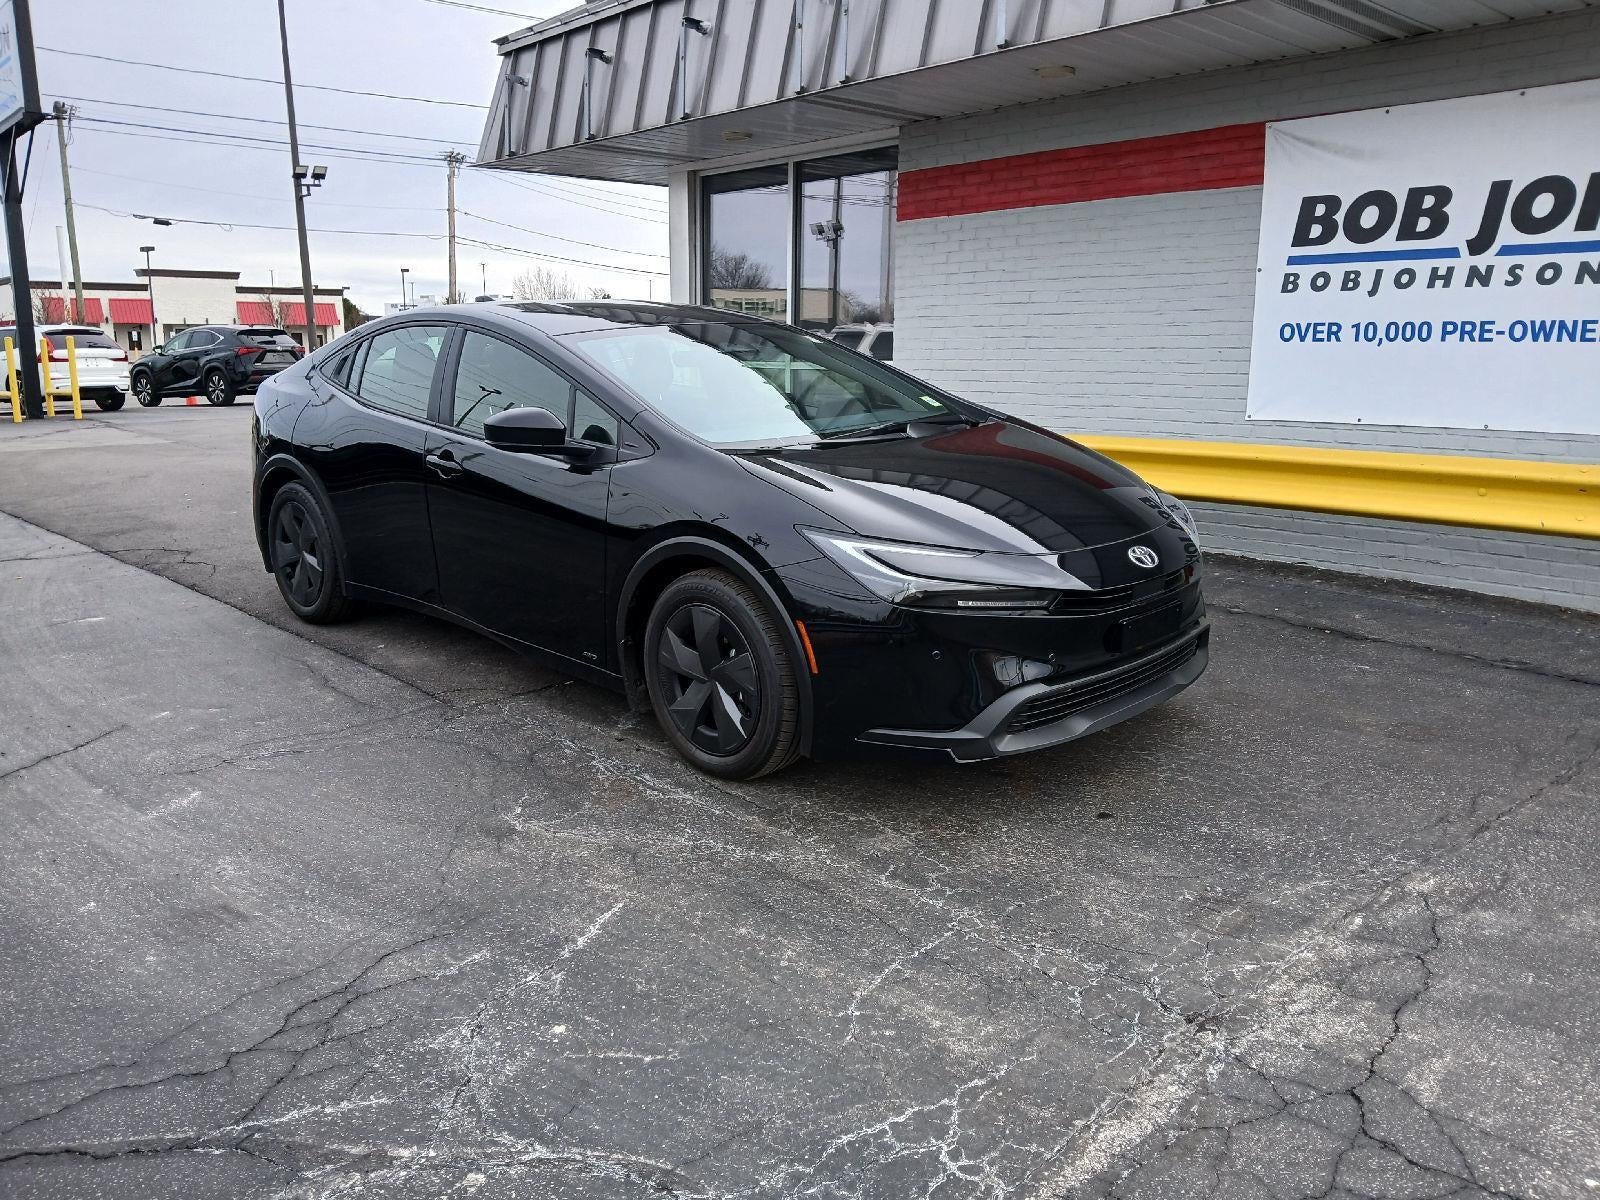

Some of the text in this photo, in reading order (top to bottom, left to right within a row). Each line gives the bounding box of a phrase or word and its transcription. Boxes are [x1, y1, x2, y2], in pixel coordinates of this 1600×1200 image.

[1290, 184, 1454, 248] BOB
[1280, 260, 1600, 298] BOBJOHNSON
[1279, 319, 1600, 347] OVER 10,000 PRE-OWNE
